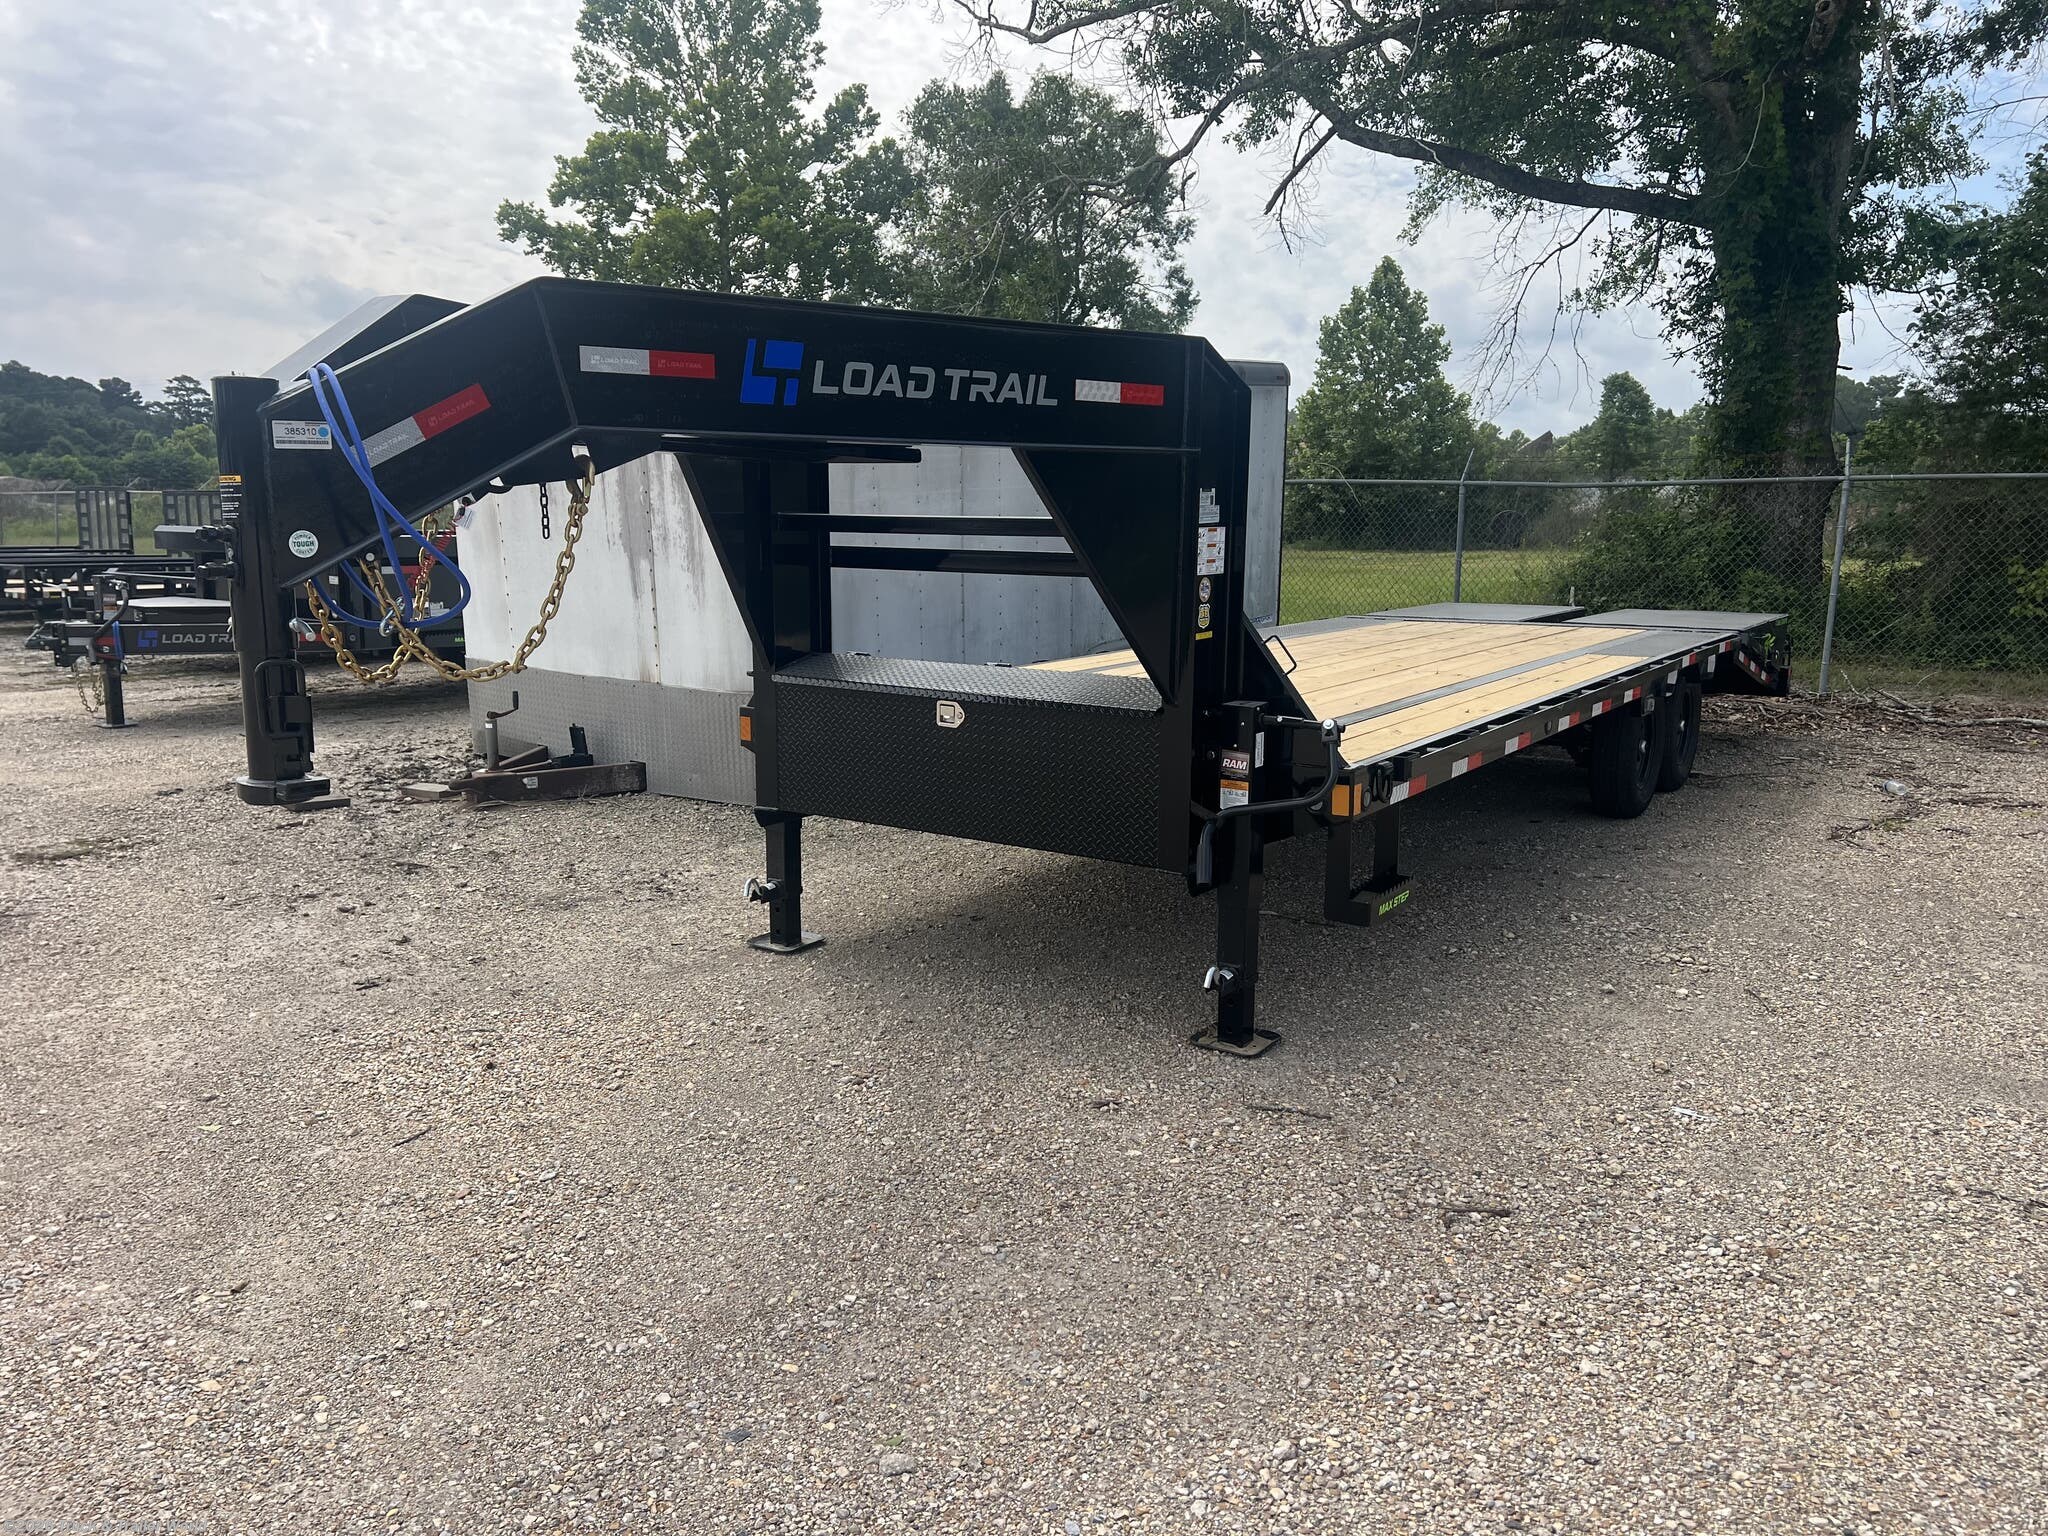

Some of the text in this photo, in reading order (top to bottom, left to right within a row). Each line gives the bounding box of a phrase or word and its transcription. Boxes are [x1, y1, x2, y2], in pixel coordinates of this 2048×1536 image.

[812, 359, 1058, 406] LOAD TRAIL
[284, 427, 317, 436] 385310
[293, 540, 315, 548] TOUGH
[161, 633, 235, 643] LOAD TRA
[1222, 758, 1247, 770] RAM
[1378, 890, 1410, 916] MAX STEP
